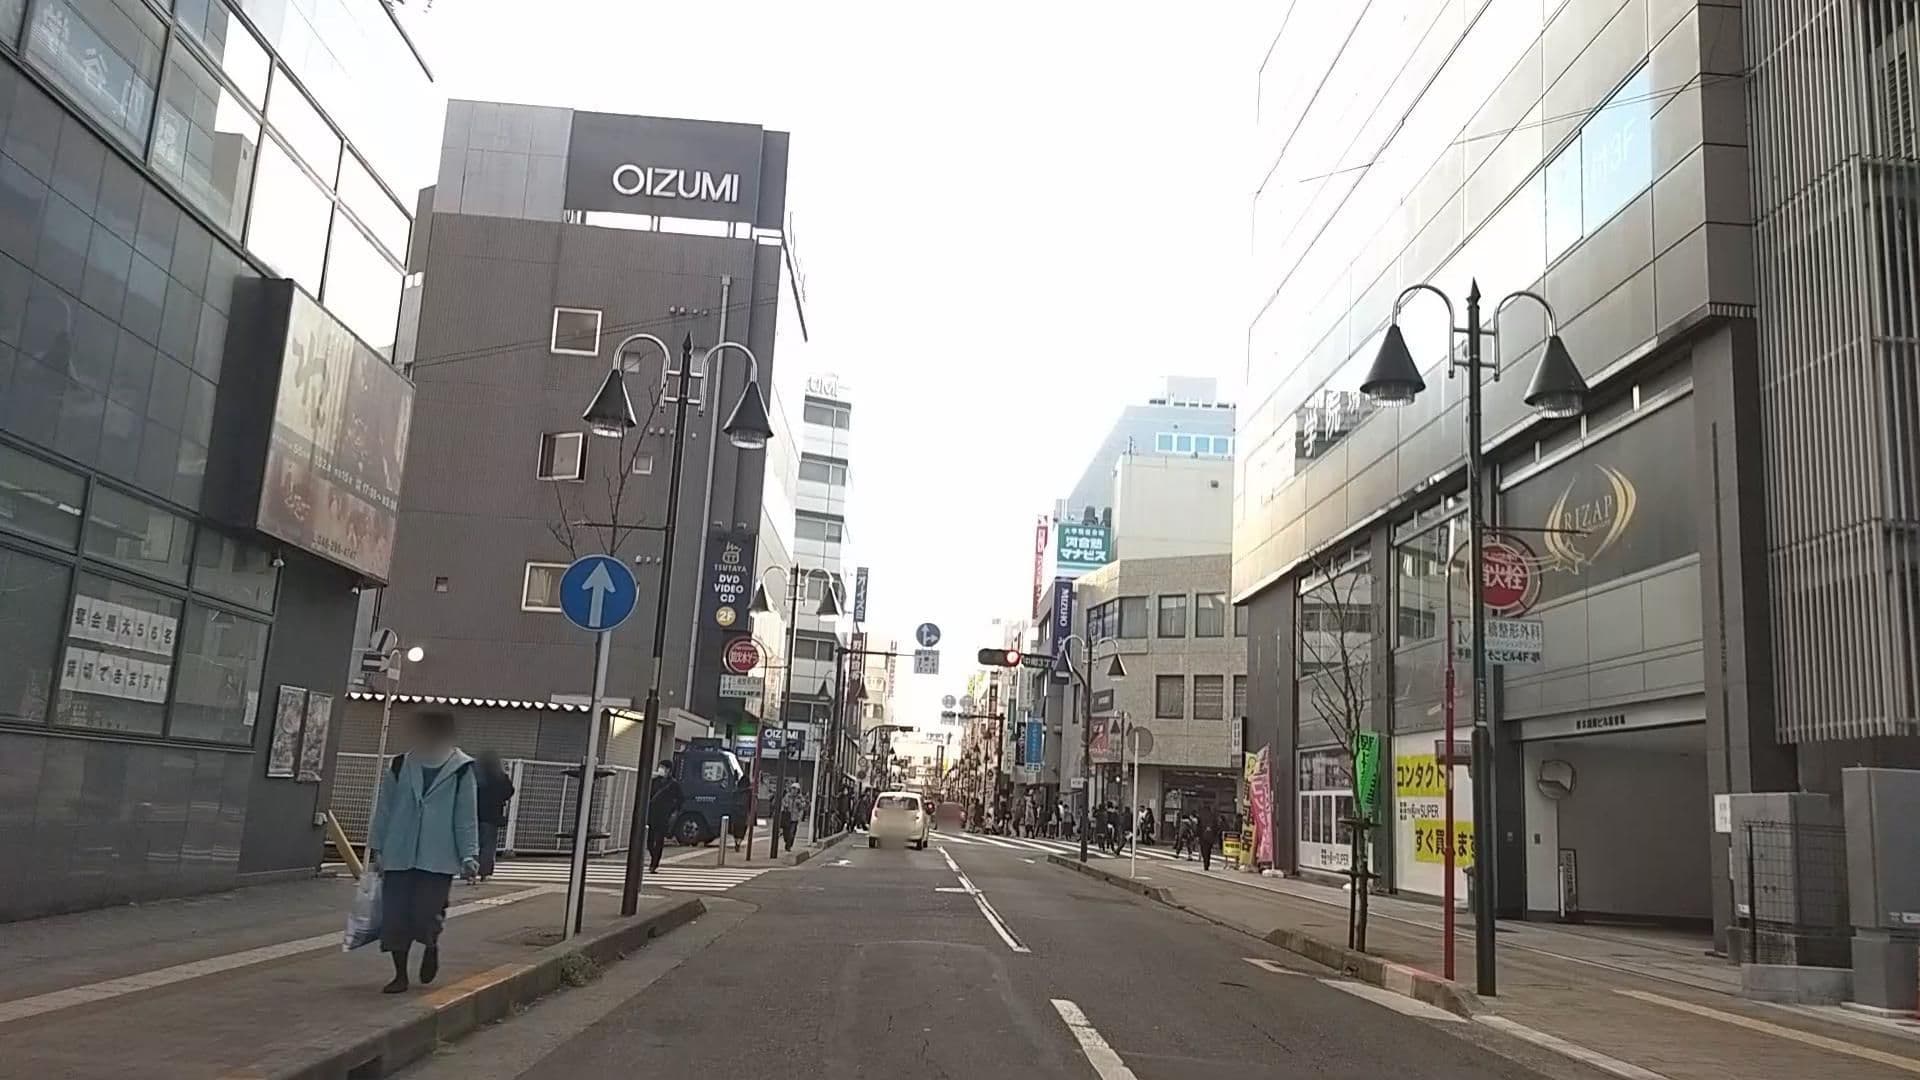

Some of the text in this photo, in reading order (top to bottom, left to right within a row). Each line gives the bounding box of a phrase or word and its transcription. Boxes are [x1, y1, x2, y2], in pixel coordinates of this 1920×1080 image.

[612, 163, 740, 204] OIZUMI
[1564, 495, 1613, 531] RIZAP
[1065, 536, 1103, 550] 河合塾
[1060, 548, 1107, 562] マナビス
[714, 563, 748, 573] TSUTAYA
[719, 574, 740, 584] DVD
[714, 584, 744, 593] VIDEO
[720, 594, 736, 603] CD
[719, 611, 732, 622] 2F
[764, 728, 799, 740] OIZMI
[1396, 762, 1445, 789] コンタクト
[1415, 828, 1476, 858] すぐ買ま
